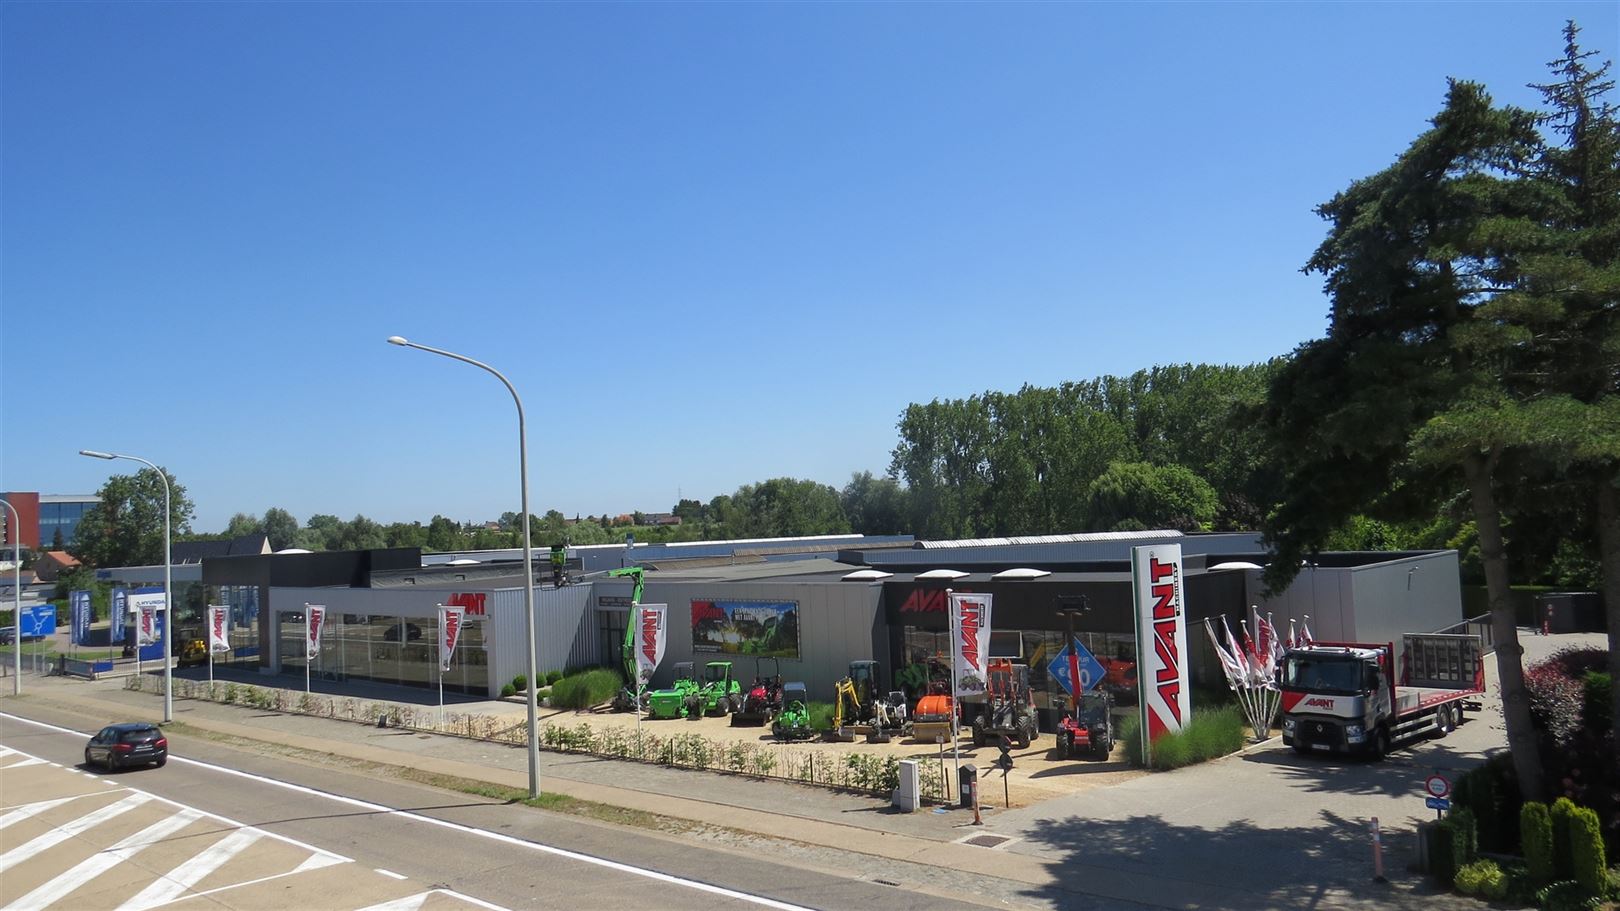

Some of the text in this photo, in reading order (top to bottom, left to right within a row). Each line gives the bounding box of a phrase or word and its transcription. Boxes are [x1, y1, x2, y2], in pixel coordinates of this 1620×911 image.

[214, 609, 224, 640] AVANT
[446, 610, 458, 653] AVANT
[642, 609, 657, 666] AVANT
[960, 600, 979, 671] AVANT
[1150, 558, 1181, 728] AVANT
[1304, 698, 1335, 708] AVANT
